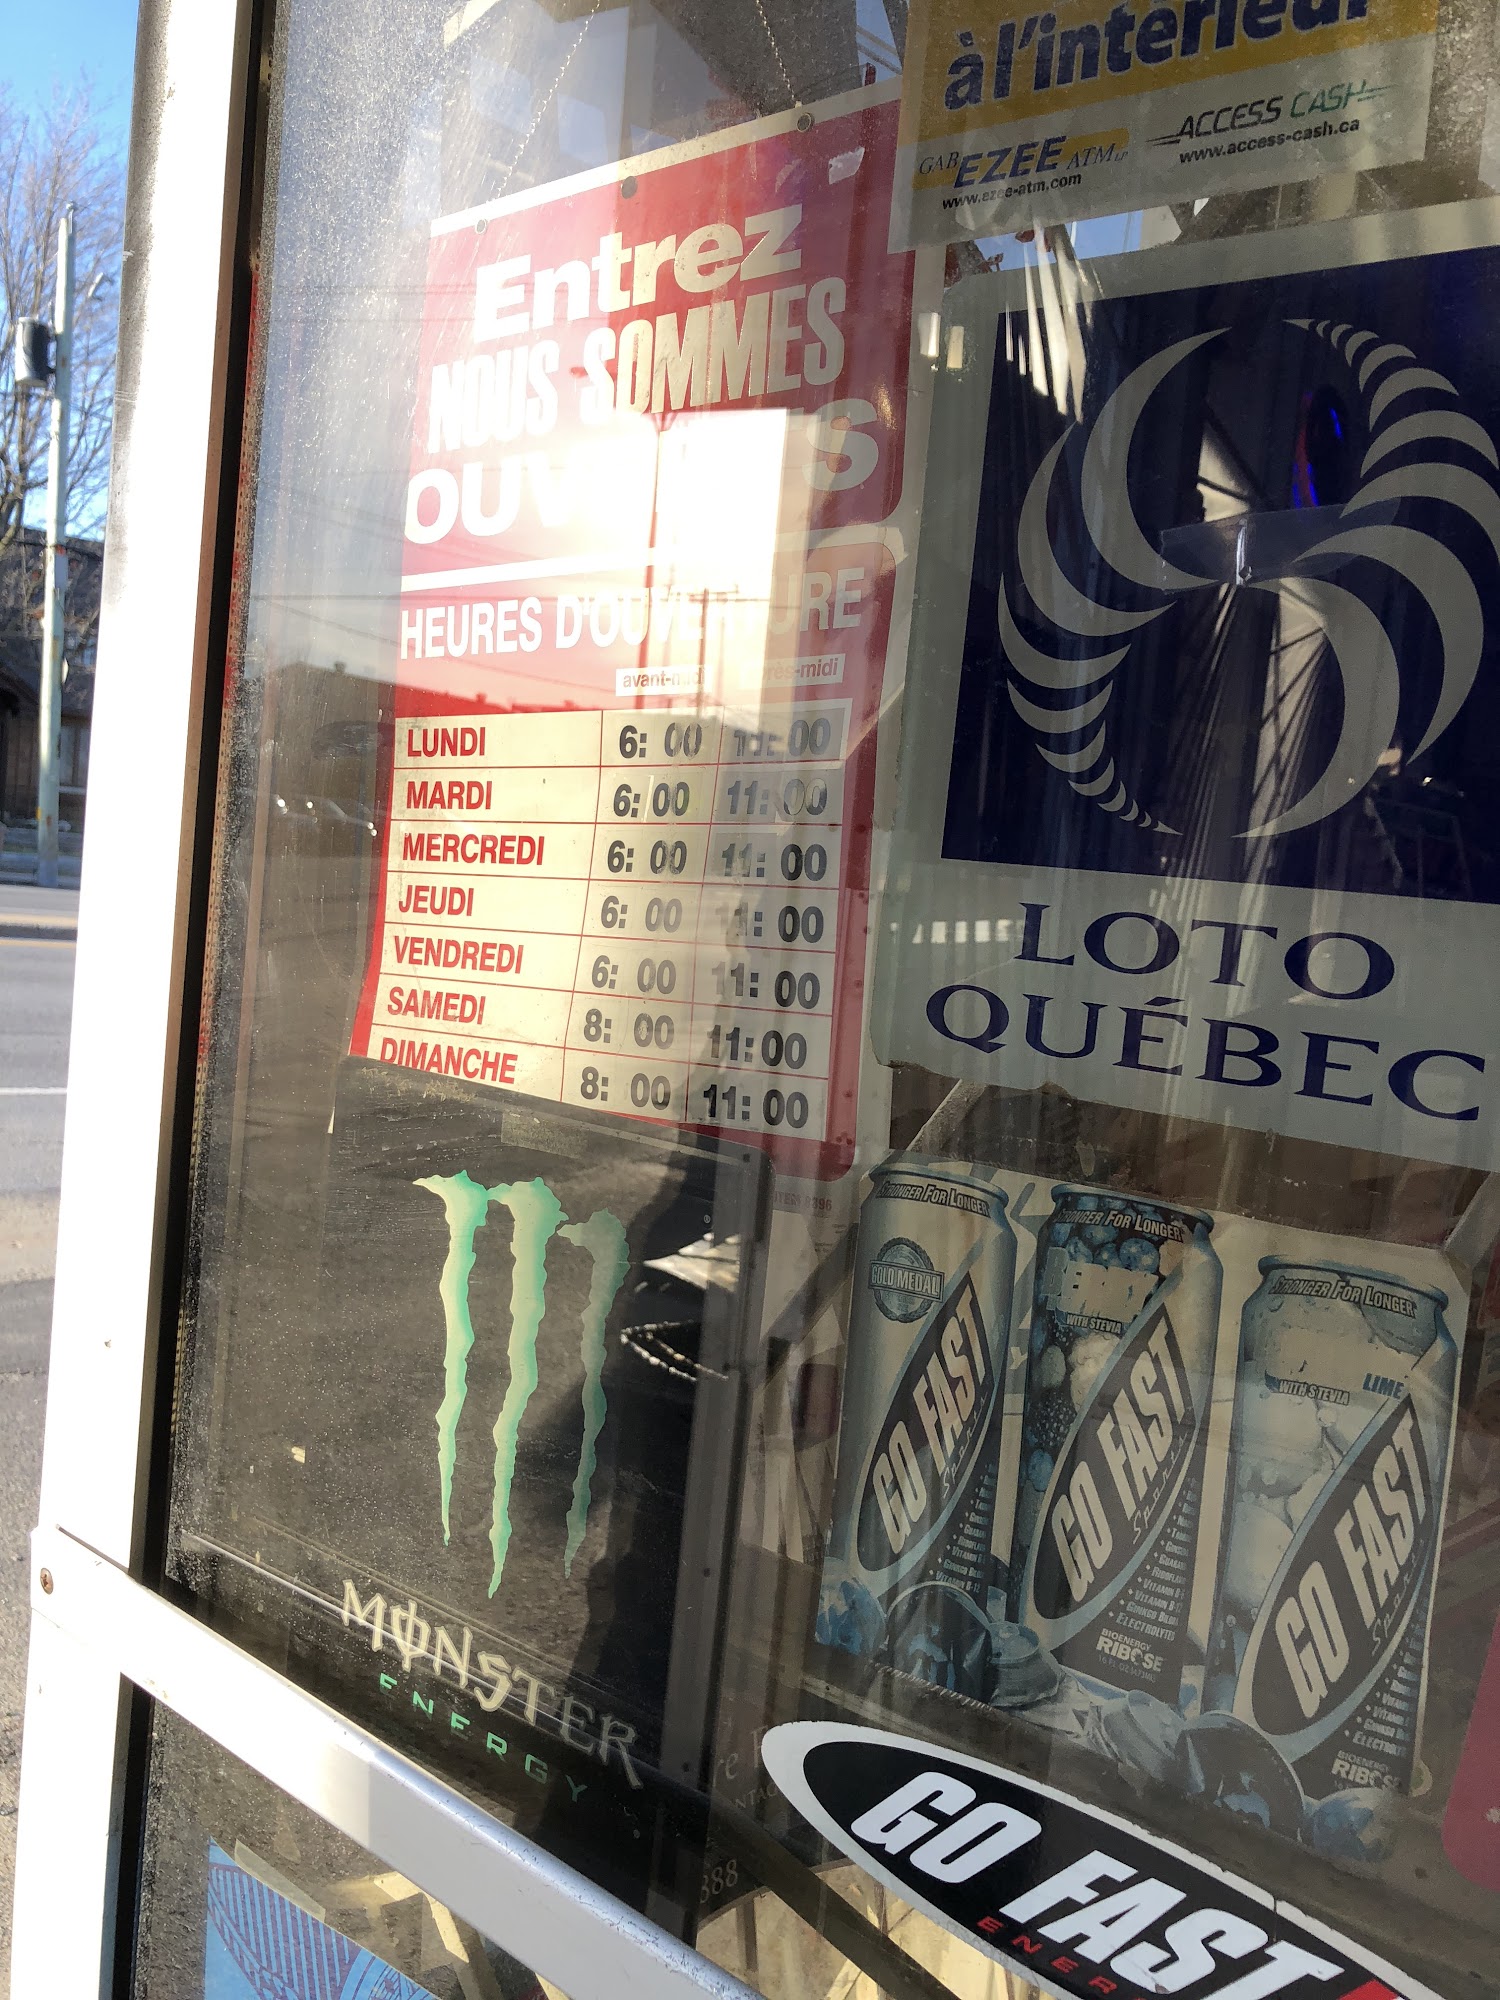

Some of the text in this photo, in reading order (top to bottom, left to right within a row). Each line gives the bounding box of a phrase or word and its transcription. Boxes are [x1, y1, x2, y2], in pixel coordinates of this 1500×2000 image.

[1174, 79, 1368, 141] ACCESS CASH
[918, 150, 959, 177] GAB
[952, 135, 1068, 190] EZEE
[1066, 142, 1115, 171] ATM
[1178, 116, 1361, 165] www.access-cash.ca
[941, 171, 1083, 210] www.ezee-atm.com
[473, 203, 803, 343] Entrez
[427, 276, 847, 454] NOUS SOMMES
[400, 566, 868, 661] HEURES D'OUVERURE
[405, 725, 487, 758] LUNDI
[405, 778, 493, 812] MARDI
[401, 831, 546, 867] MERCREDI
[398, 883, 476, 918] JEUDI
[393, 934, 525, 975] VENDREDI
[1013, 901, 1396, 1001] LOTO
[386, 985, 487, 1027] SAMEDI
[379, 1036, 519, 1086] DIMANCHE
[925, 983, 1487, 1121] QUÉBEC
[871, 1263, 941, 1297] GOLD MEDAL
[1066, 1313, 1123, 1335] WITH STEVIA
[1279, 1378, 1350, 1406] WITH STEVIA
[872, 1419, 927, 1554] GO
[912, 1284, 986, 1478] FAST
[1050, 1459, 1113, 1604] GO
[1097, 1325, 1191, 1521] FAST
[1273, 1407, 1429, 1719] GO FAST
[1095, 1635, 1165, 1674] RIBOSE
[1101, 1627, 1153, 1652] BIOENERGY
[342, 1579, 643, 1789] MONSTER
[379, 1671, 588, 1802] ENERGY
[850, 1770, 1346, 2000] GO FAST
[976, 1915, 1148, 2000] ENER
